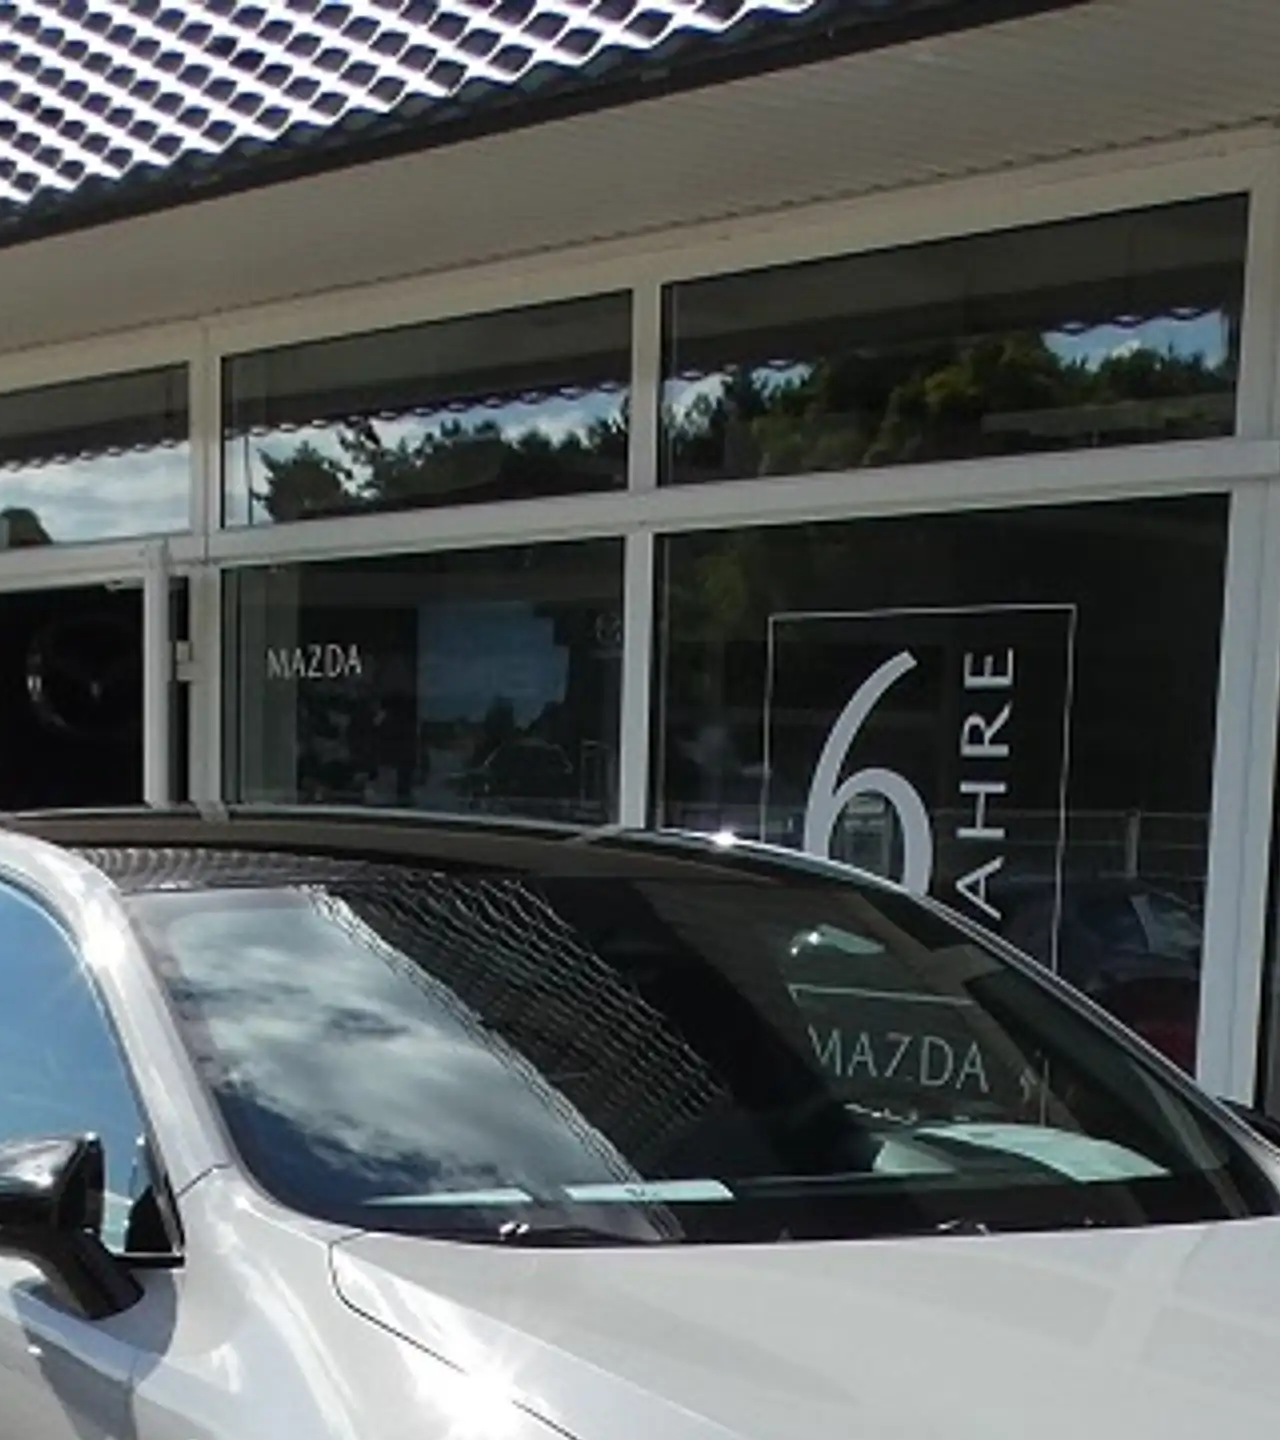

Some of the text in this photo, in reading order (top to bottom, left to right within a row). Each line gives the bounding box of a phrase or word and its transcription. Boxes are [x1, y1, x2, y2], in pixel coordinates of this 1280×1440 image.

[266, 643, 362, 679] MAZDA
[804, 649, 933, 895] 6
[955, 647, 1014, 920] AHRE
[806, 1023, 990, 1093] MAZDA
